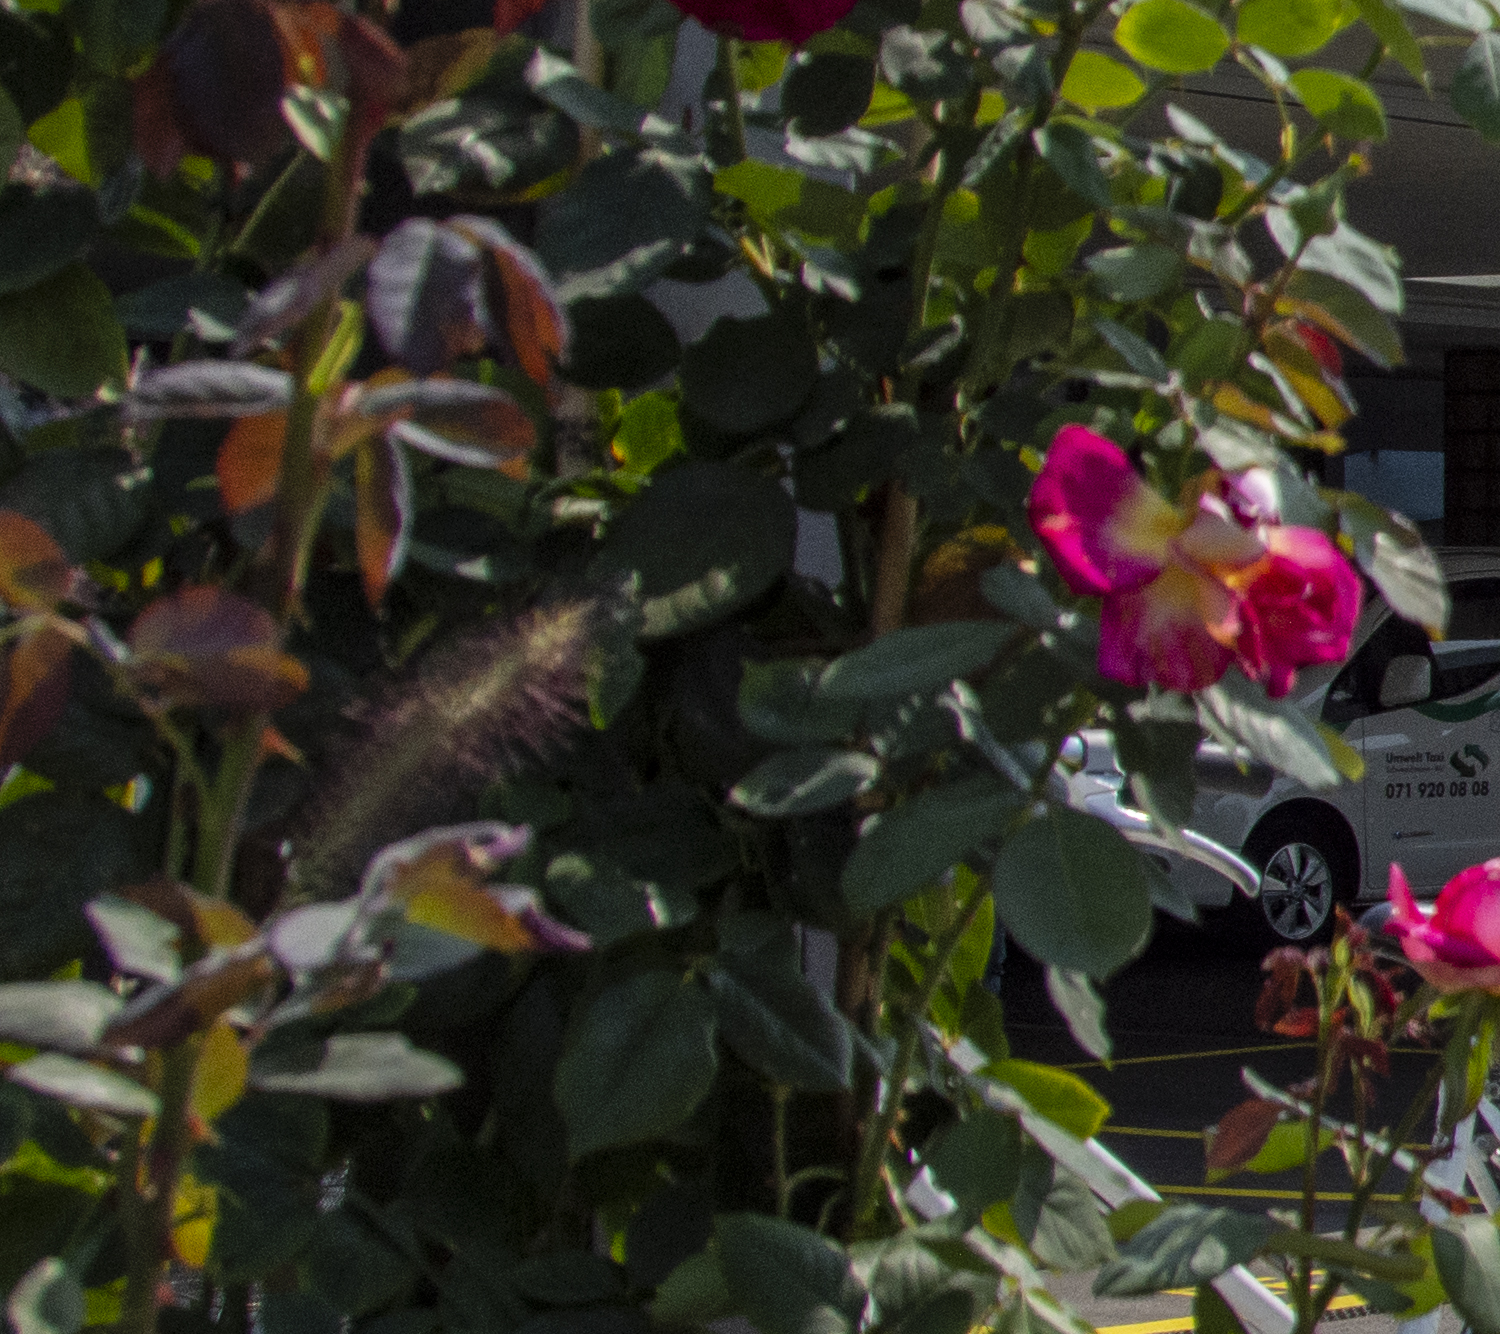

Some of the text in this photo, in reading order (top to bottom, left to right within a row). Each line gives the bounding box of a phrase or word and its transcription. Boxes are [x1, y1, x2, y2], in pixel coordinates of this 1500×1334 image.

[1425, 751, 1445, 763] Taxi
[1386, 780, 1490, 799] 071 920 08 08
